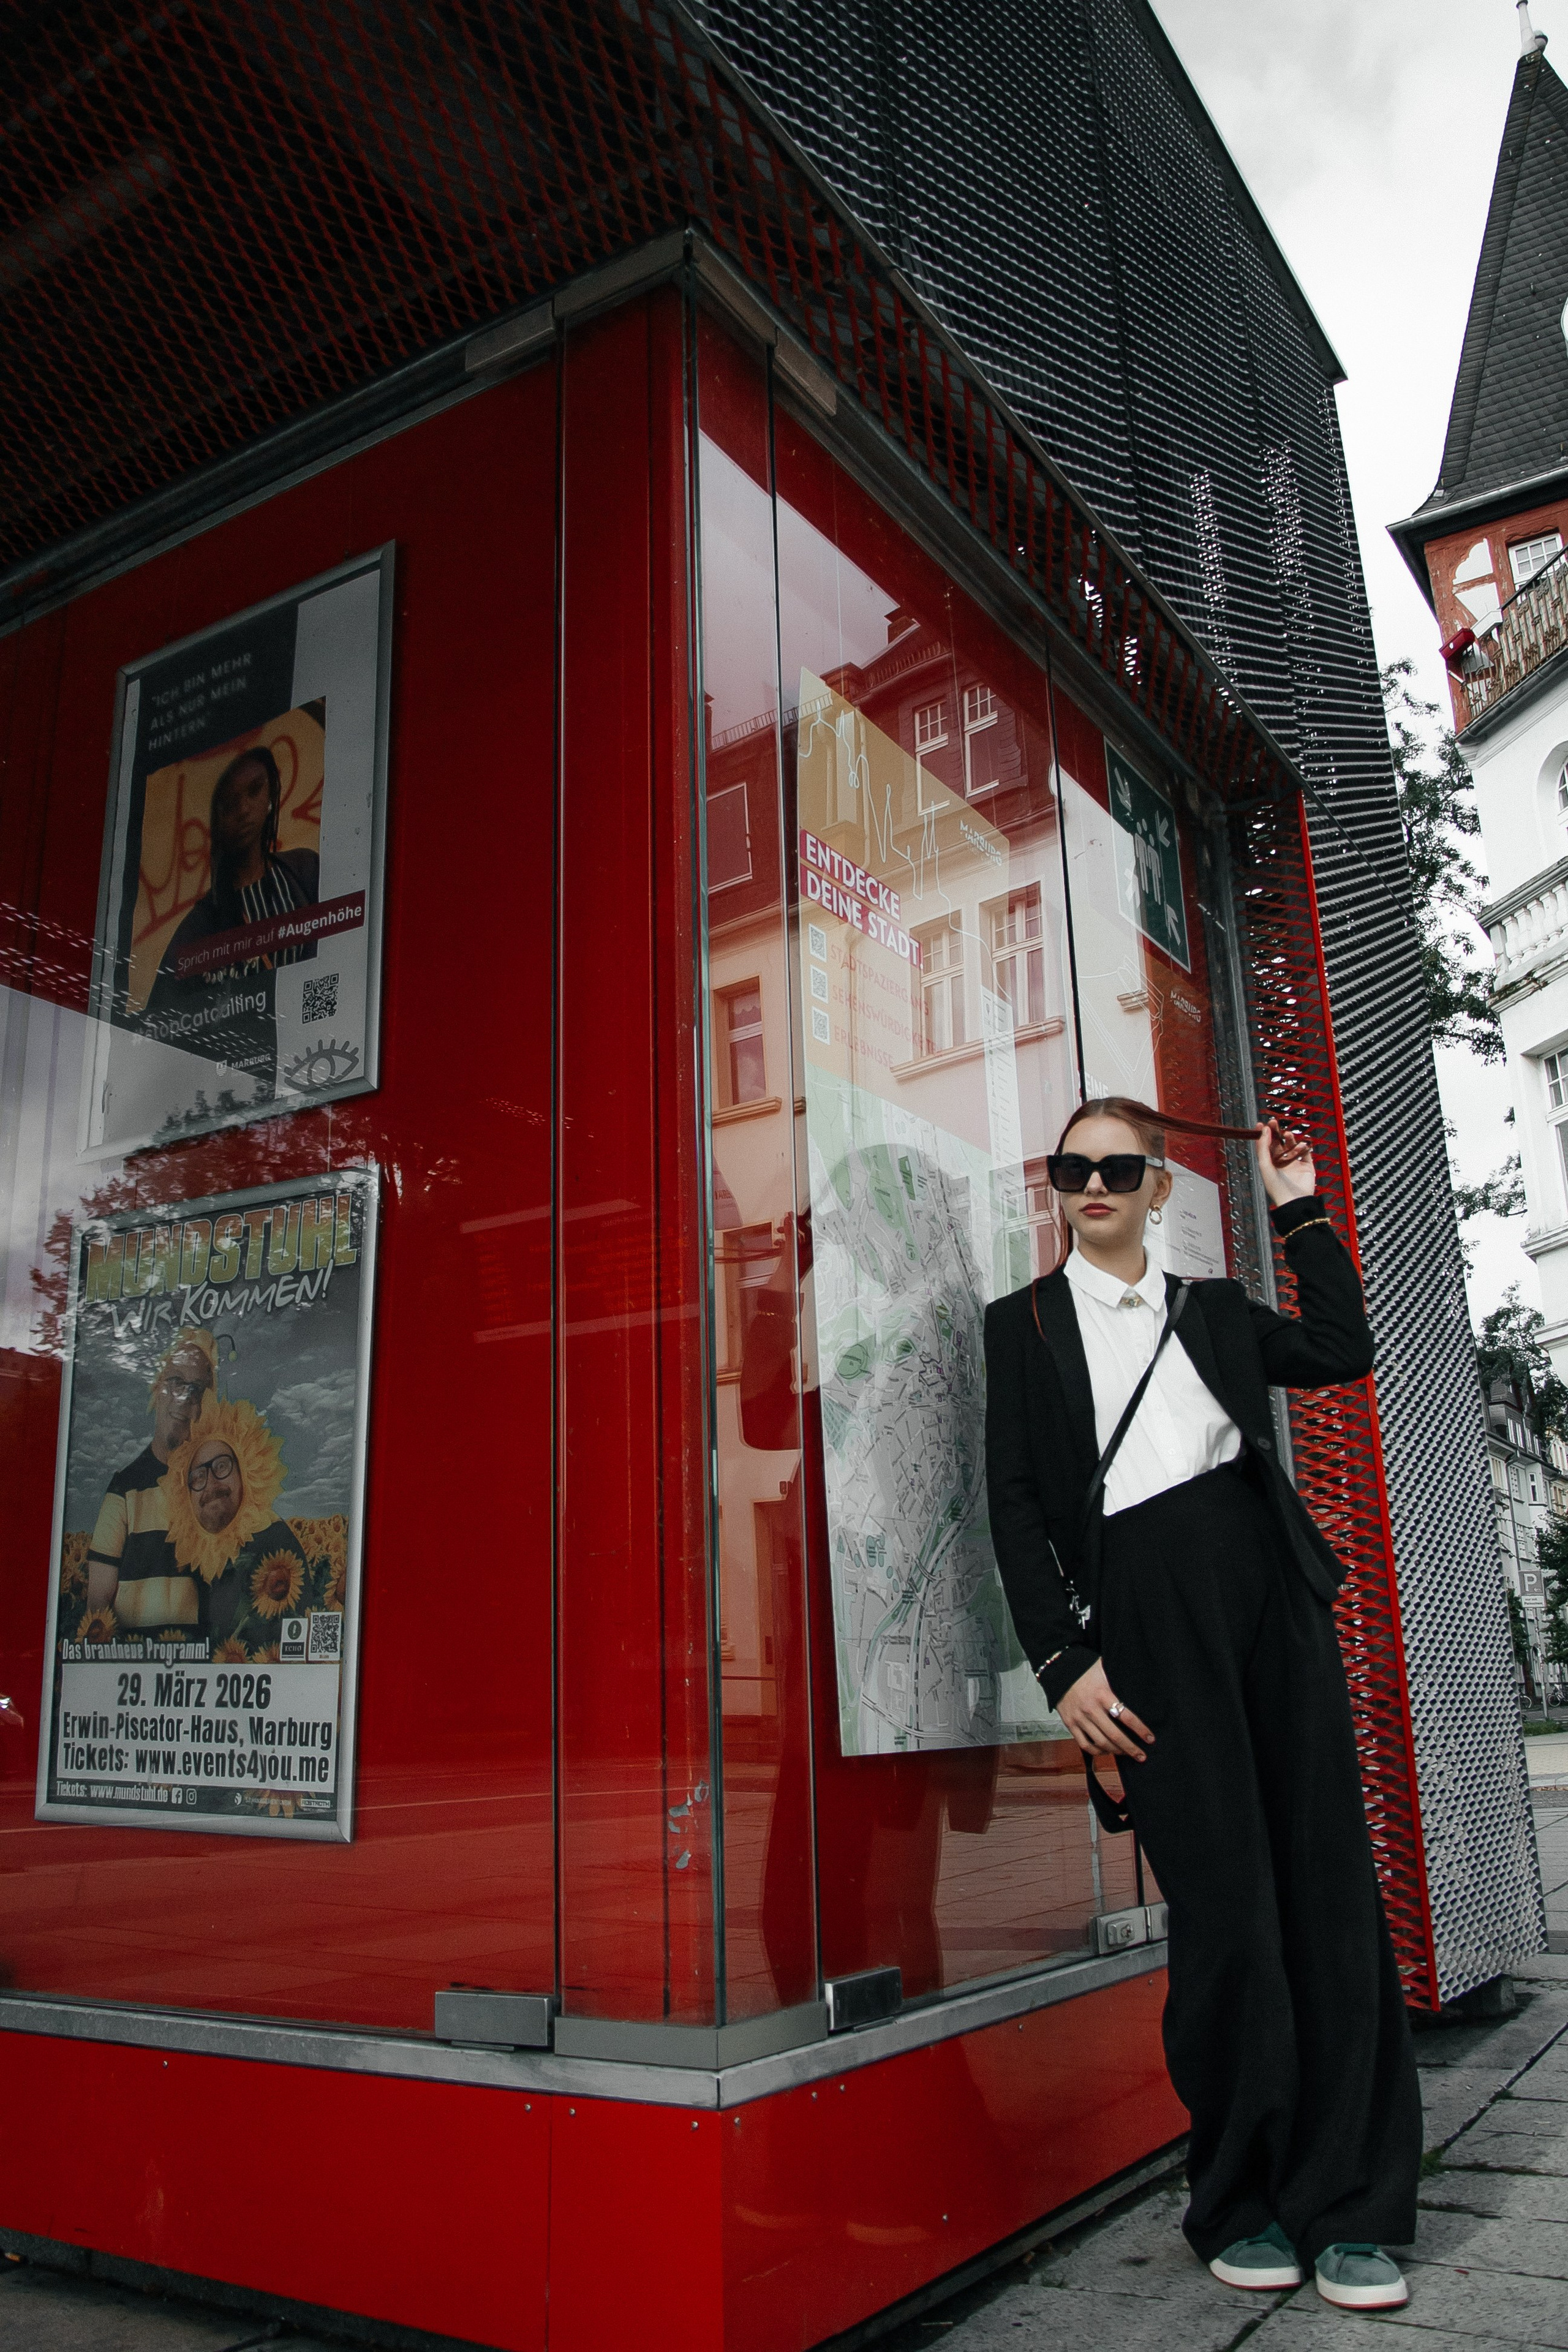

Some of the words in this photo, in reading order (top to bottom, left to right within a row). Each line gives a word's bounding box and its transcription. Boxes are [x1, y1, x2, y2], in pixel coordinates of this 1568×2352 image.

[183, 672, 205, 693] BIN
[211, 652, 252, 679] MEHR
[150, 710, 174, 731] ALS
[178, 693, 205, 717] NUR
[210, 675, 247, 701] MEIN
[806, 833, 900, 921] ENTDECKE
[178, 951, 209, 973] Sprich
[212, 944, 230, 959] mit
[233, 937, 253, 952] mir
[255, 927, 275, 947] auf
[277, 905, 362, 940] #Augenhöhe
[807, 870, 862, 930] DEINE
[868, 911, 923, 970] STADT.
[834, 1025, 894, 1068] ERLEBNISSE
[84, 1193, 358, 1306] MUNDSTUHL
[111, 1298, 173, 1338] WIR
[179, 1259, 334, 1327] KOMMEN!
[1523, 1574, 1537, 1591] P
[62, 1638, 82, 1660] Das
[84, 1637, 144, 1660] brandneue
[146, 1636, 210, 1667] Programm!
[116, 1672, 146, 1706] 29.
[154, 1670, 208, 1708] März
[214, 1673, 272, 1710] 2026
[63, 1711, 244, 1748] Erwin-Piscator-Haus,
[249, 1717, 333, 1751] Marburg
[63, 1741, 129, 1773] Tickets:
[135, 1748, 330, 1783] www.events4you.me
[56, 1780, 88, 1797] Tickets:
[89, 1784, 168, 1803] www.mundstuhl.de
